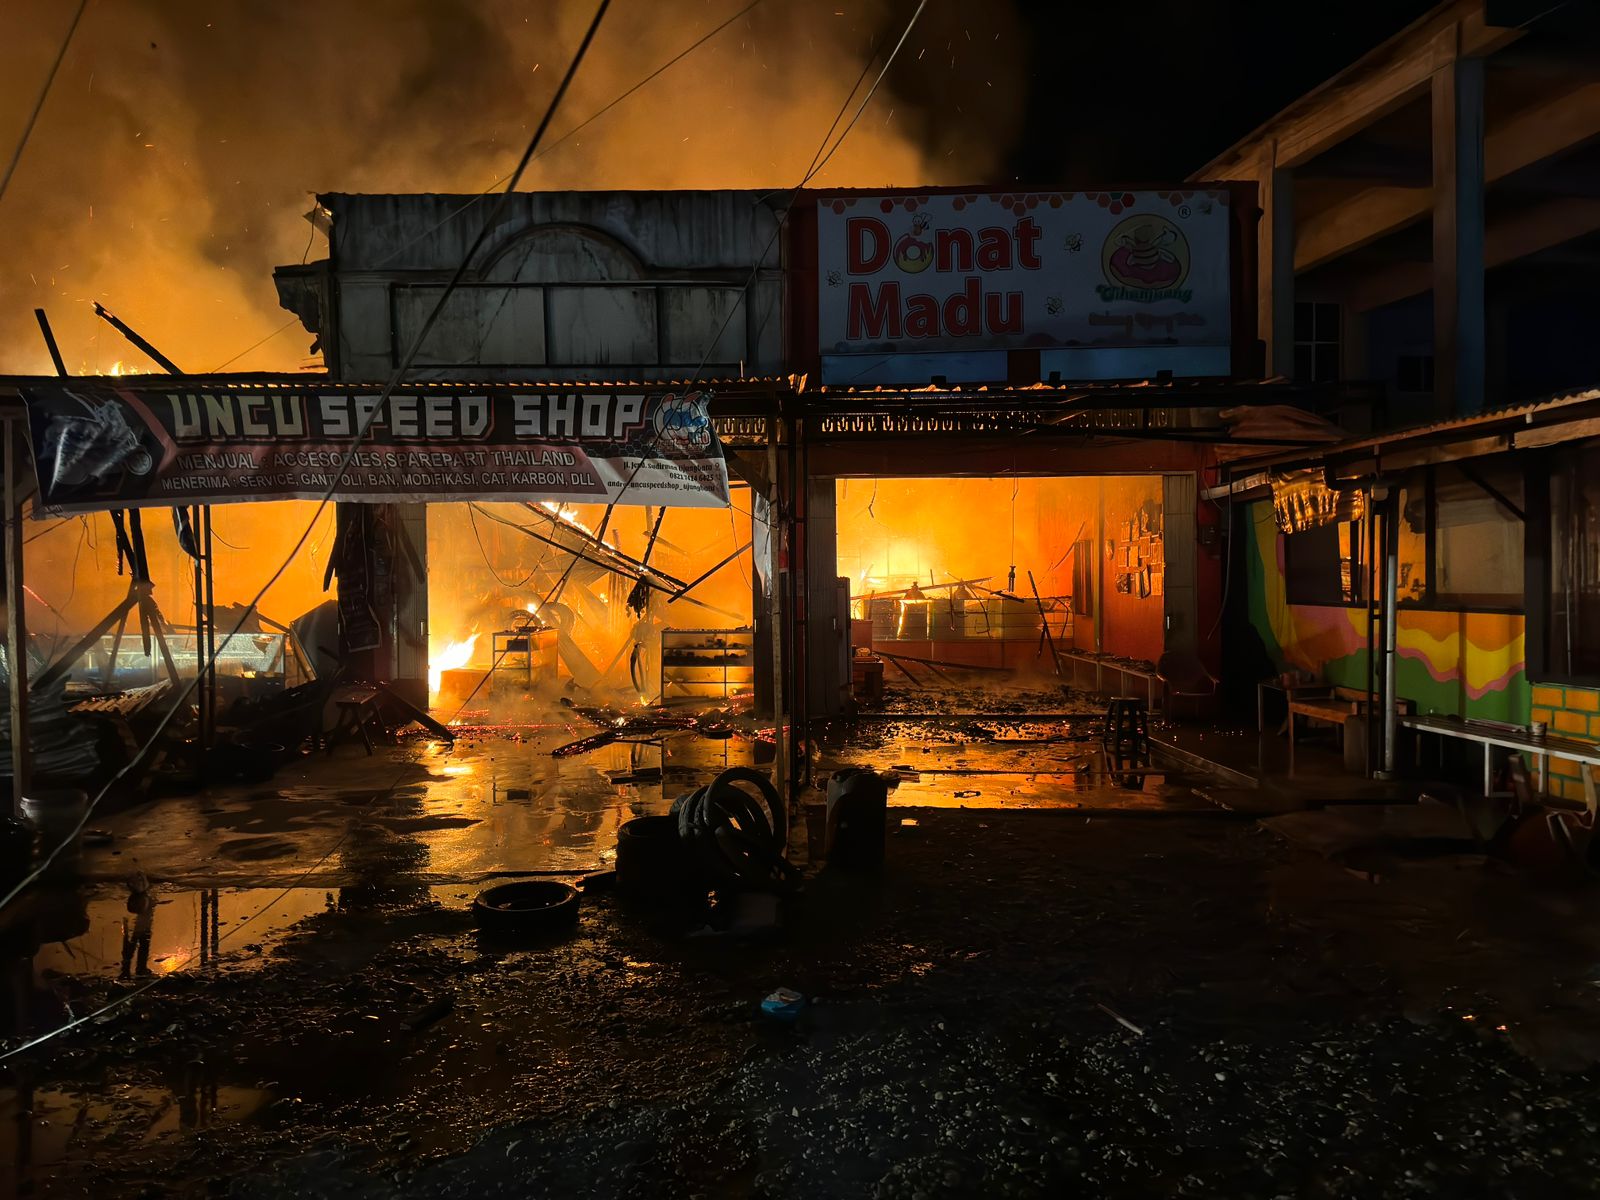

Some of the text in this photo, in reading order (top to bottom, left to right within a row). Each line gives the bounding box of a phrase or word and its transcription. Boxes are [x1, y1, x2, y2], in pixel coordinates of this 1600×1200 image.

[846, 276, 1024, 341] Madu
[167, 394, 645, 438] UNCU SPEED SHOP
[176, 453, 260, 470] MENJUAL
[490, 451, 576, 468] THAILAND
[162, 476, 231, 491] MENERIMA
[239, 473, 299, 488] SERVICE,
[301, 472, 335, 486] GANT
[341, 473, 366, 488] OLI,
[369, 473, 399, 488] BAN,
[402, 472, 479, 488] MODIFIKASI,
[481, 471, 509, 486] CAT,
[511, 471, 569, 487] KARBON,
[571, 472, 596, 486] DLL
